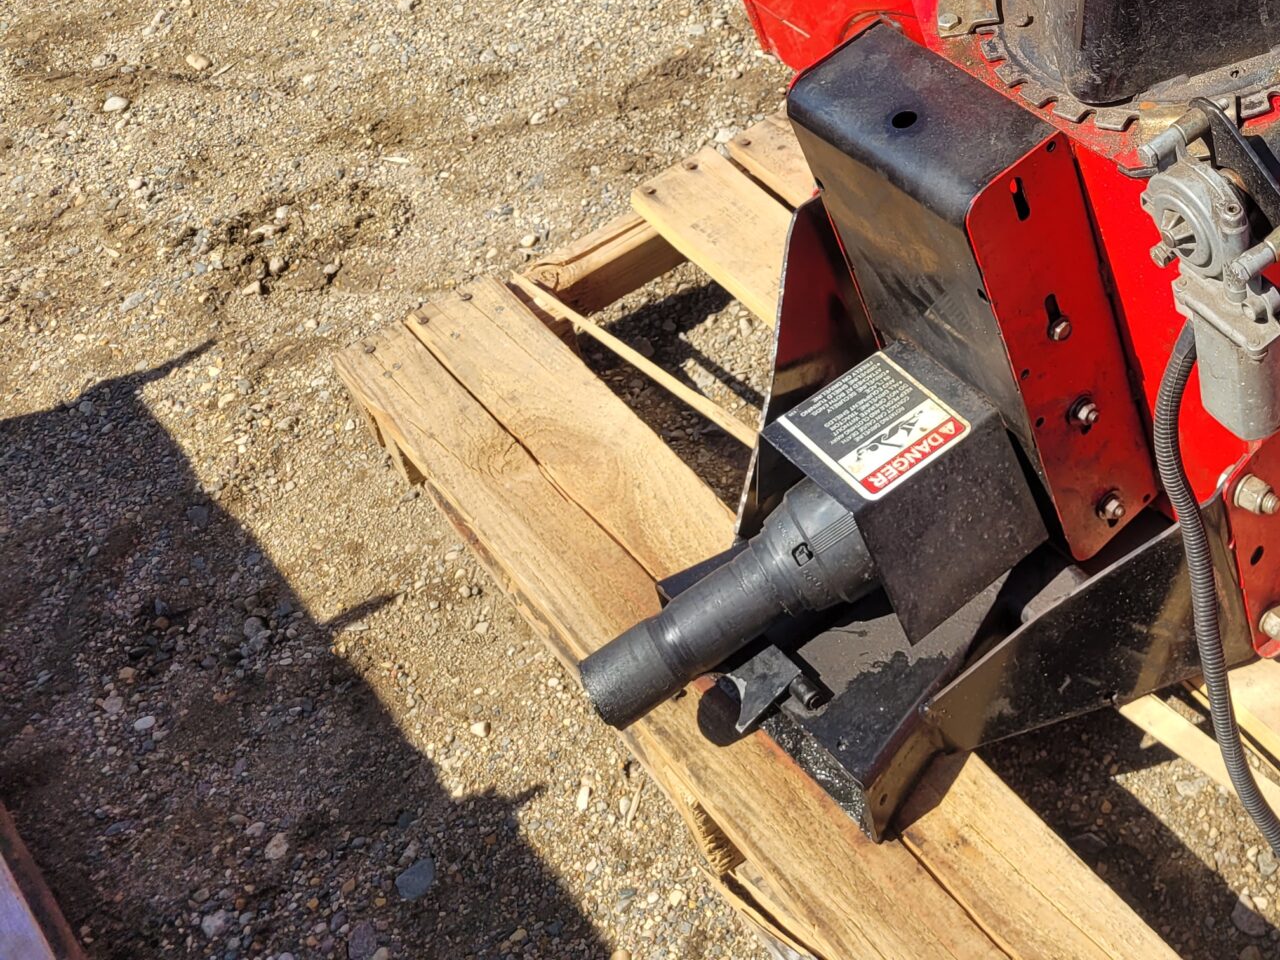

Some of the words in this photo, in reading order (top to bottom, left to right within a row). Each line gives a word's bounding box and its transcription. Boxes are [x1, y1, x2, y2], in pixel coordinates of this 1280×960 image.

[852, 367, 881, 388] ATTACHED
[881, 378, 895, 388] AND
[845, 386, 853, 394] AT
[886, 389, 899, 399] NOT
[828, 391, 846, 405] BOTH
[859, 397, 886, 417] OPERATE
[868, 408, 880, 418] AND
[829, 410, 858, 431] TRACTOR
[868, 433, 948, 487] DANGER
